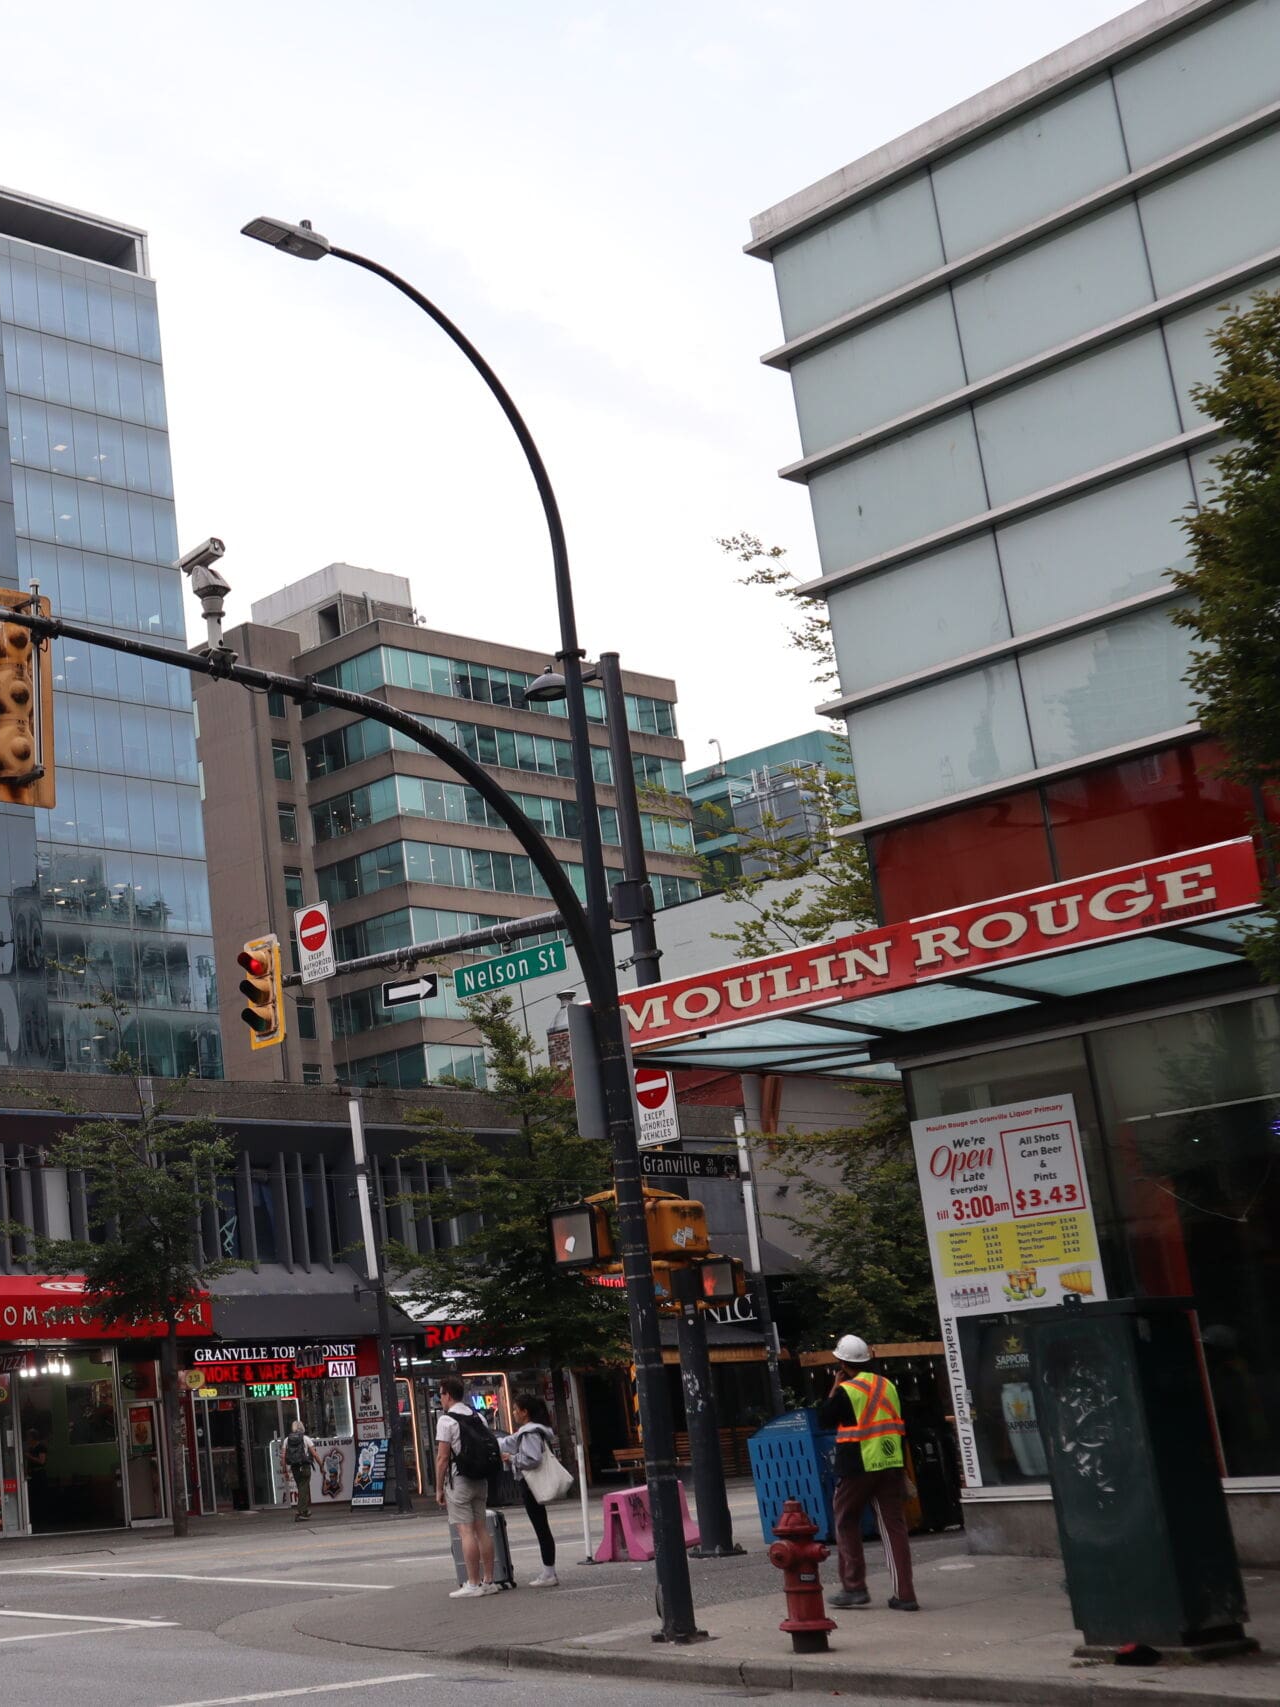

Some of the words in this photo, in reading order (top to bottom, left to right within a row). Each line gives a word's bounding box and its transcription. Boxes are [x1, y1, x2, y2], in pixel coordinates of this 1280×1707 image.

[308, 950, 325, 961] EXCEPT
[620, 941, 894, 1034] MOULIN
[913, 863, 1217, 968] ROUGE
[304, 957, 332, 971] AUTHORIZED
[308, 965, 329, 977] VEHICLES
[463, 957, 529, 992] Nelson
[538, 947, 558, 972] St
[643, 1110, 666, 1122] EXCEPT
[926, 1123, 947, 1133] Moulin
[979, 1113, 1008, 1125] Granville
[1009, 1109, 1033, 1119] Liquor
[1034, 1104, 1063, 1115] Primary
[642, 1129, 672, 1141] VEHICLES
[1019, 1134, 1033, 1146] All
[1034, 1132, 1060, 1144] Shots
[952, 1136, 986, 1150] We're
[1020, 1148, 1039, 1159] Can
[1041, 1145, 1063, 1156] Beer
[642, 1155, 701, 1175] Granville
[929, 1145, 994, 1182] Open
[1039, 1160, 1047, 1168] &
[962, 1172, 986, 1183] Late
[1033, 1172, 1058, 1182] Pints
[950, 1183, 988, 1196] Everyday
[1015, 1184, 1078, 1211] $3.43
[936, 1209, 949, 1221] till
[194, 1346, 268, 1362] GRANVILLE
[271, 1343, 357, 1359] TOBONIST
[296, 1351, 324, 1368] ATM
[244, 1364, 254, 1381] &
[258, 1363, 289, 1381] VAPE
[331, 1361, 354, 1377] ATM
[471, 1394, 498, 1410] VAPE
[943, 1317, 960, 1373] Breakfast
[962, 1436, 976, 1480] Dinner
